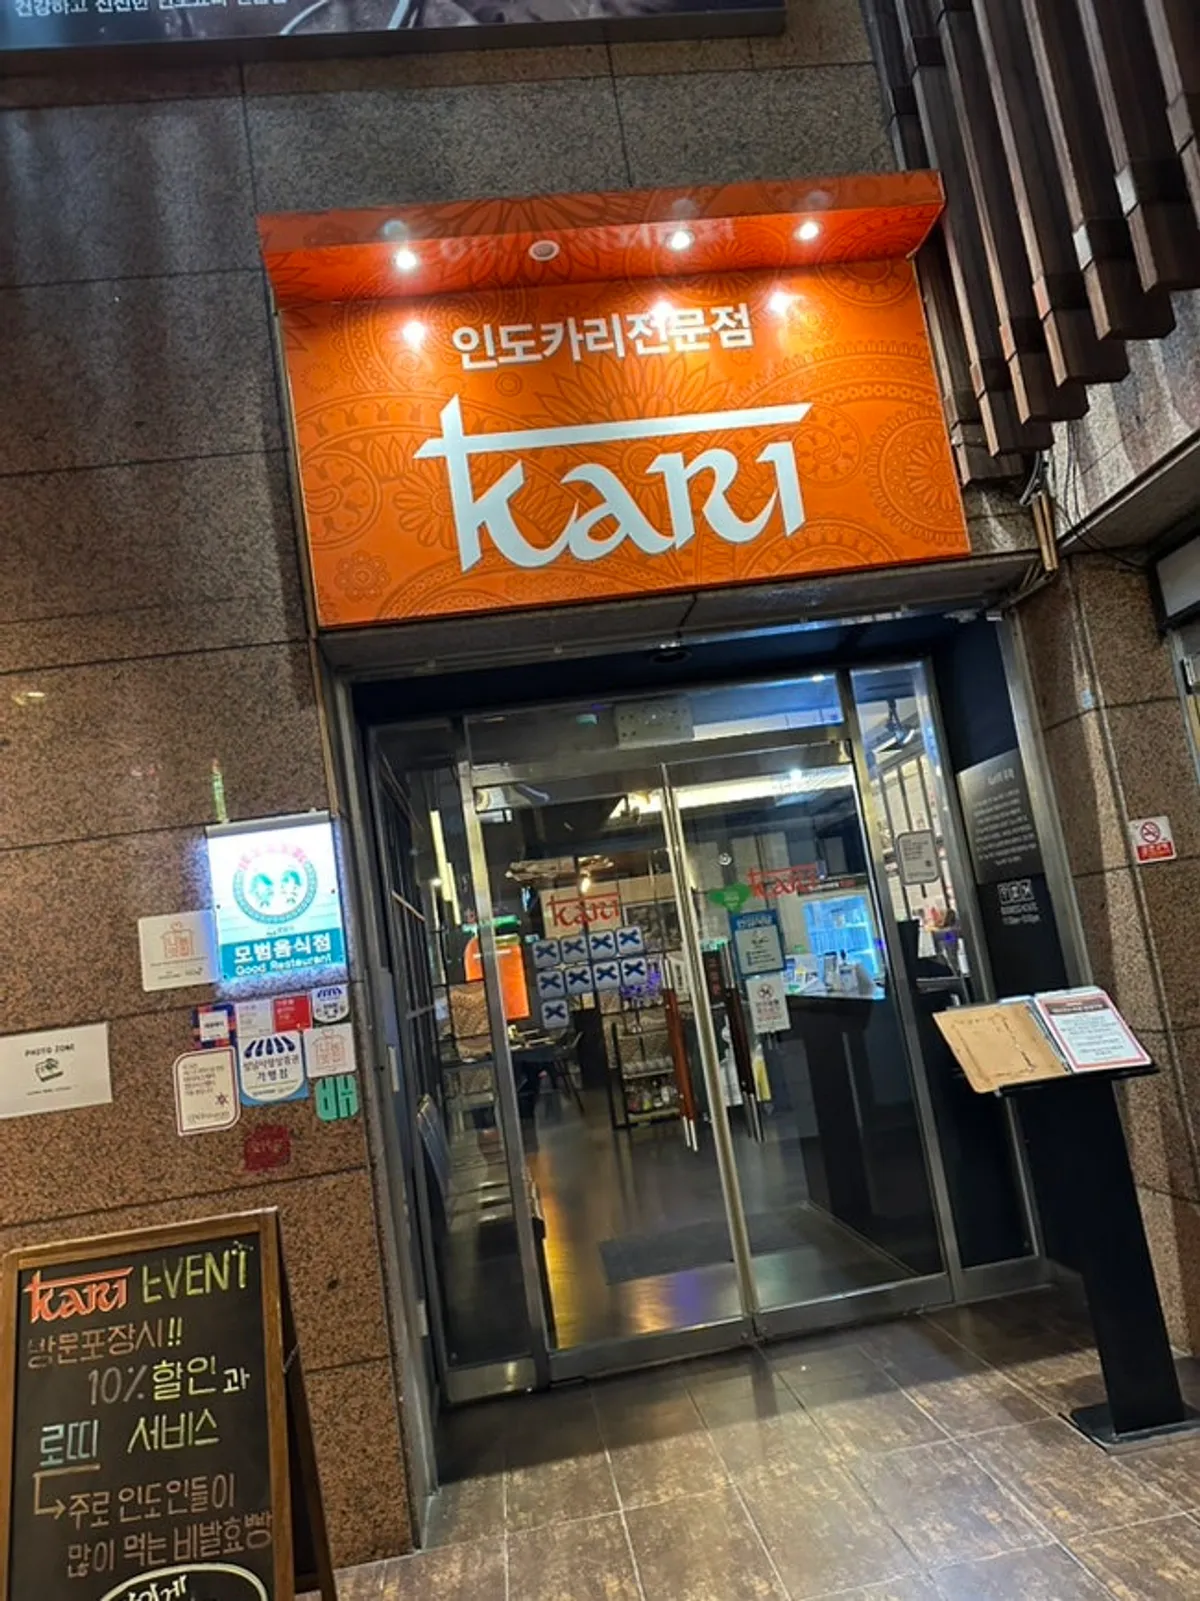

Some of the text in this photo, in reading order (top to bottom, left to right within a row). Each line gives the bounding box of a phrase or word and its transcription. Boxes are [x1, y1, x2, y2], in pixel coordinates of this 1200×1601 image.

[451, 302, 754, 371] 인도카리전문점
[234, 932, 331, 964] 모범음식점
[141, 1244, 250, 1303] EVENT
[88, 1364, 148, 1406] 10%
[40, 1408, 220, 1467] 로띠 서비스
[68, 1473, 235, 1529] 주로 인도인들이
[67, 1539, 115, 1578] 많이
[123, 1530, 167, 1567] 먹는
